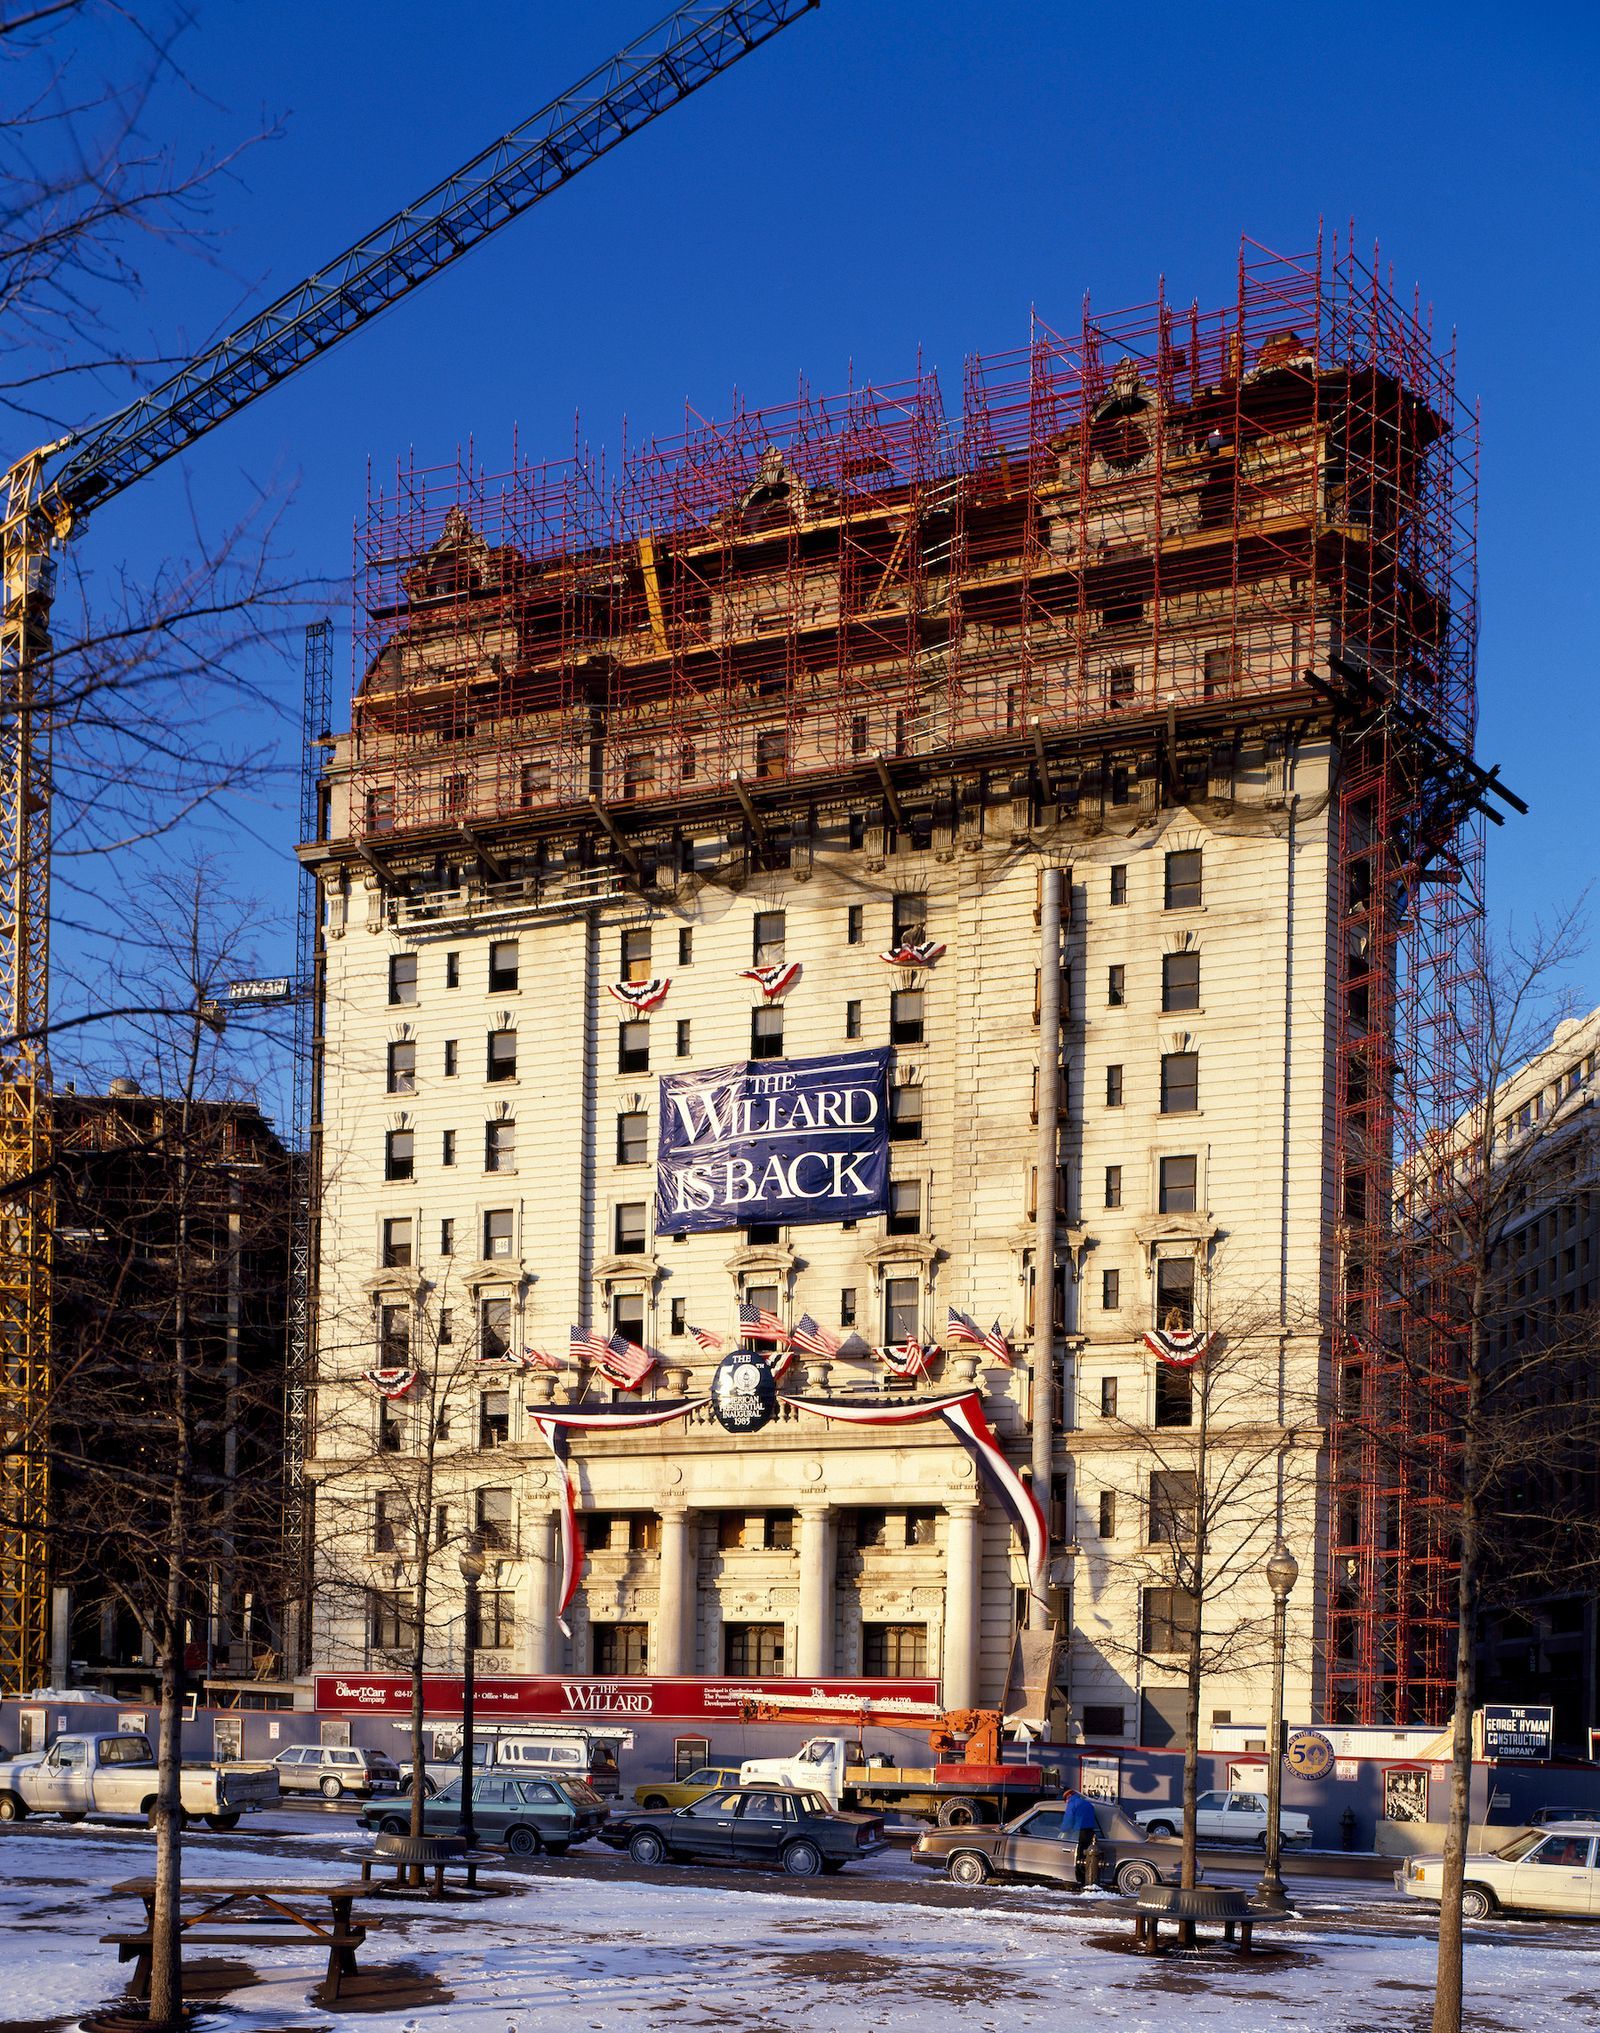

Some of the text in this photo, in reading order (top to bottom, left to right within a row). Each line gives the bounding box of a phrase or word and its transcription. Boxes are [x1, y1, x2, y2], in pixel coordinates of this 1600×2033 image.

[231, 981, 284, 996] HYMAN
[749, 1073, 798, 1095] THE
[667, 1080, 878, 1144] WILLARD
[671, 1151, 875, 1214] IS BACK
[732, 1354, 752, 1364] THE
[719, 1403, 765, 1411] PRESIDENTIAL
[722, 1410, 762, 1418] INAUGURAL
[598, 1685, 618, 1694] THE
[811, 1687, 824, 1695] The
[359, 1696, 386, 1704] Company
[482, 1692, 499, 1700] Office
[561, 1685, 653, 1712] WILLARD
[1511, 1709, 1525, 1718] THE
[1486, 1719, 1550, 1732] GEORGE HYMAN
[1487, 1732, 1546, 1746] CONSTRUCTION
[1498, 1746, 1536, 1755] COMPANY
